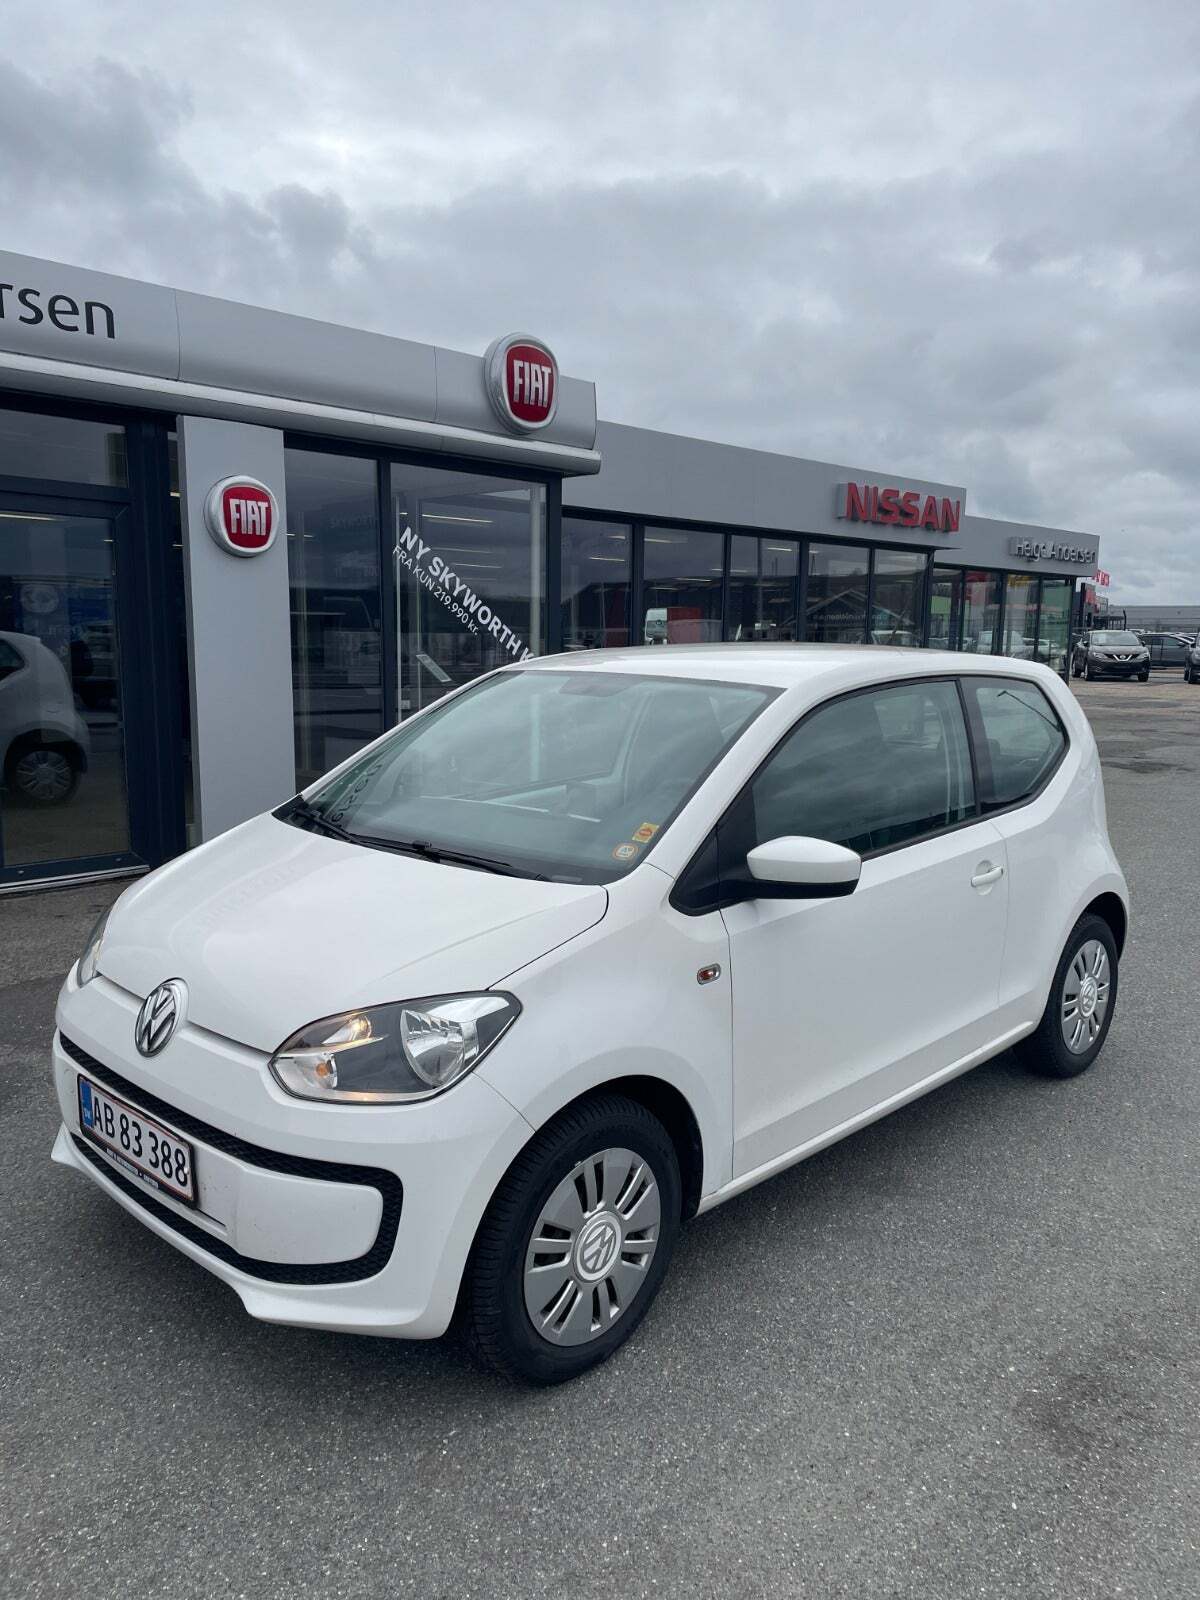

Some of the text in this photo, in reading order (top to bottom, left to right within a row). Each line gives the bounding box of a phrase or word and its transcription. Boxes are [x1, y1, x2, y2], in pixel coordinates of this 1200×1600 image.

[0, 283, 116, 339] rsen
[513, 359, 552, 408] FIAT
[229, 498, 270, 536] FIAT
[846, 482, 961, 532] NISSAN
[392, 545, 479, 636] FRA KUN 219.990 kr.
[399, 526, 432, 560] NY
[428, 556, 522, 655] SKYWORTH
[93, 1096, 116, 1139] AB
[119, 1113, 143, 1158] 83
[148, 1131, 188, 1187] 388
